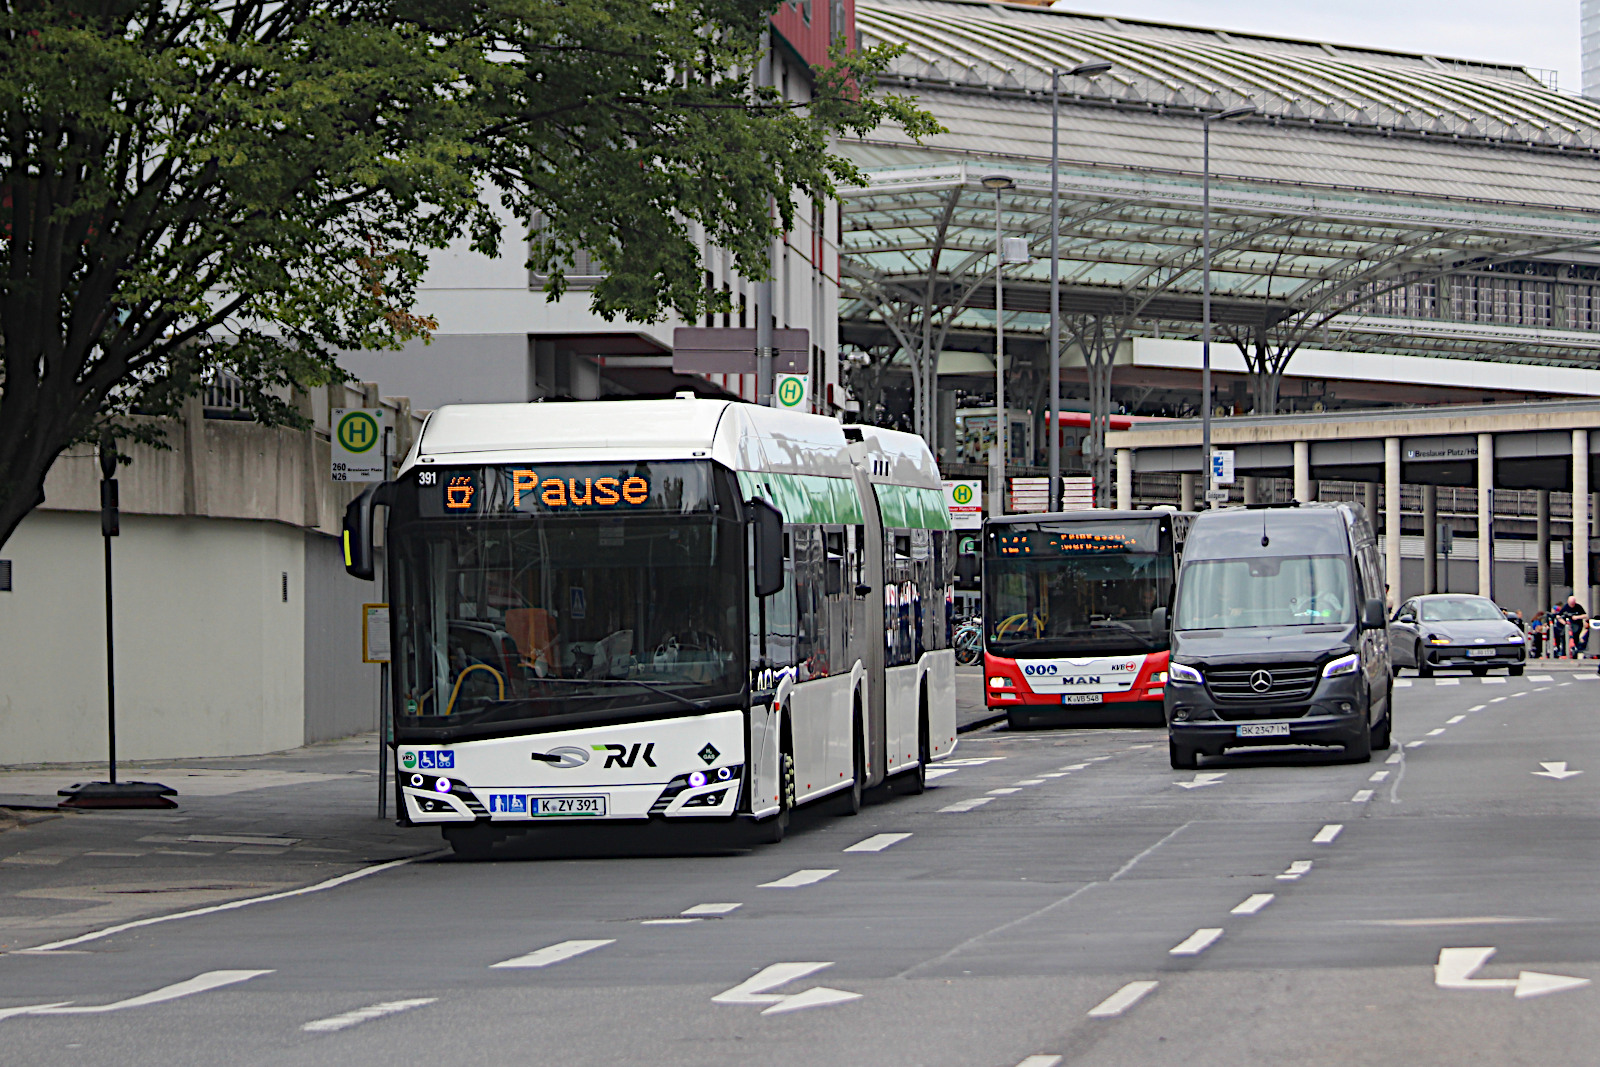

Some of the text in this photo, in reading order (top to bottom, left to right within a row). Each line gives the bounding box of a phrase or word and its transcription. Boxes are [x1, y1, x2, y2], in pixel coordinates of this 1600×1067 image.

[349, 421, 366, 443] H
[1415, 450, 1446, 458] Breslauer
[332, 463, 346, 471] 260
[332, 473, 347, 481] N26
[418, 471, 437, 485] 391
[512, 469, 648, 507] Pause
[1062, 676, 1100, 685] MAN
[1241, 726, 1254, 735] BK
[1255, 725, 1275, 735] 2347
[542, 799, 599, 812] K ZY 391
